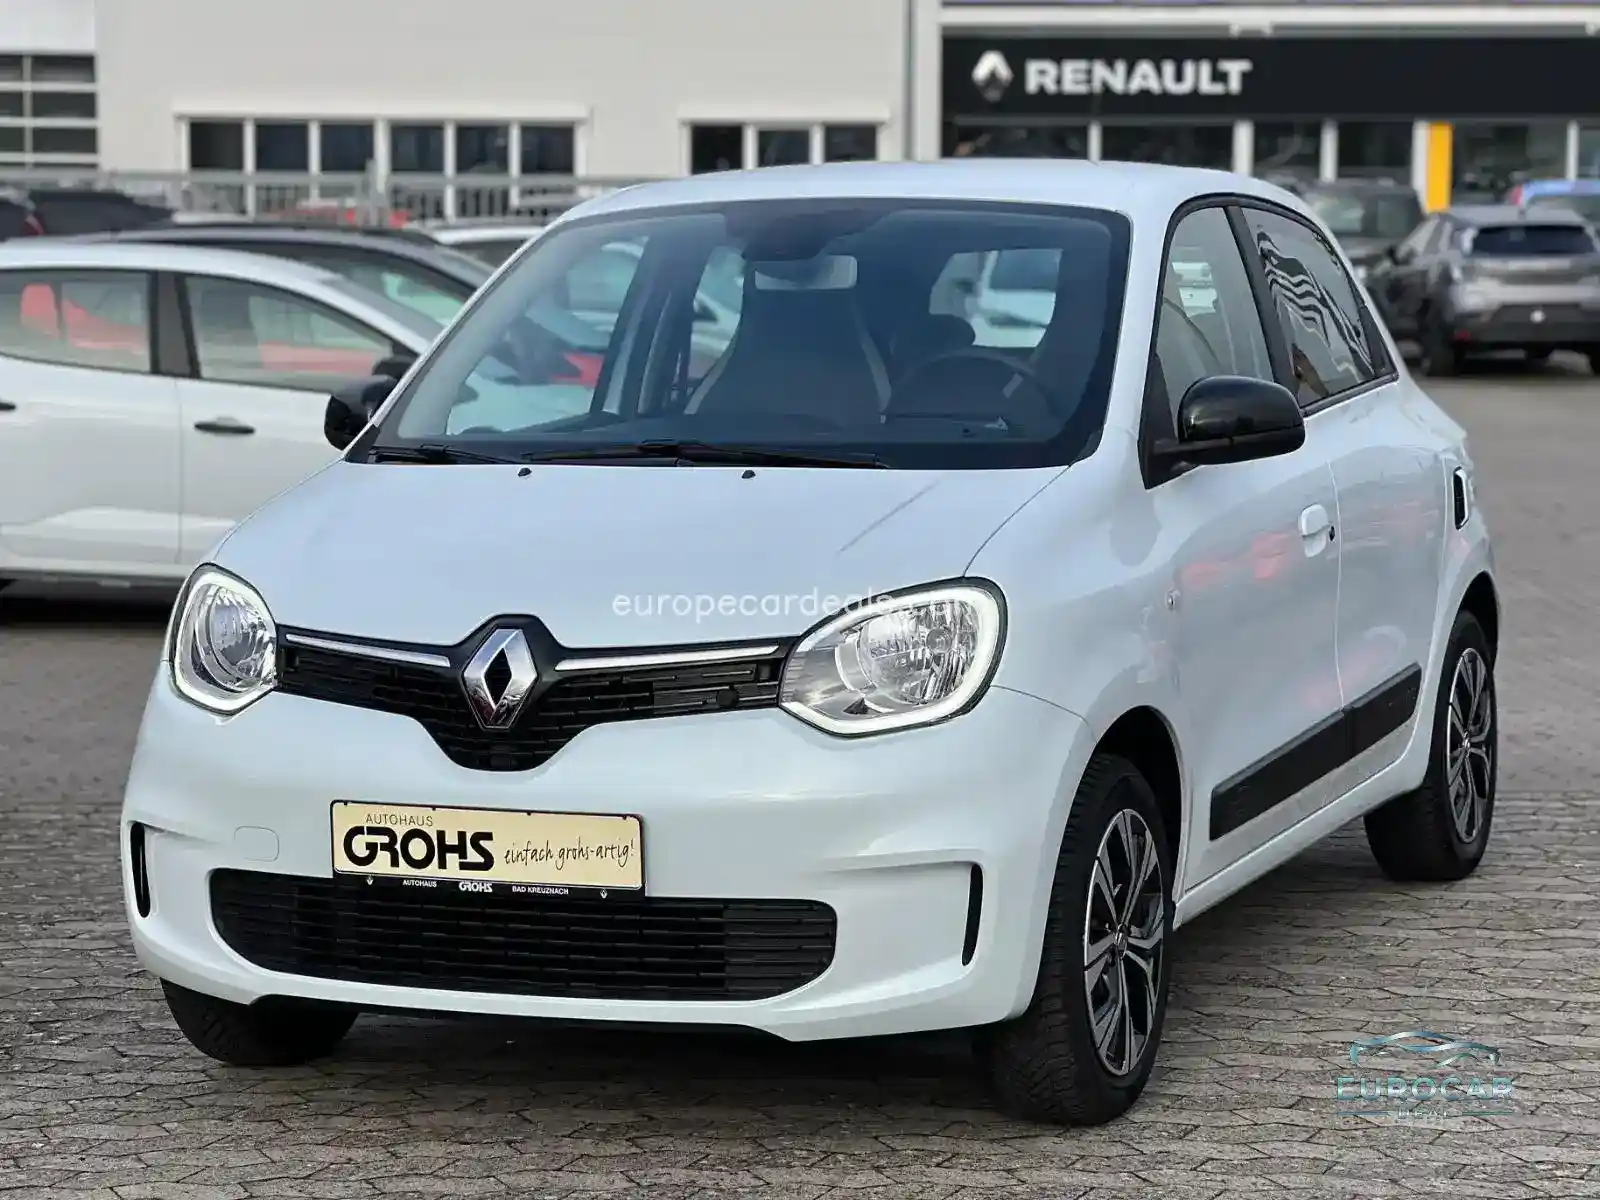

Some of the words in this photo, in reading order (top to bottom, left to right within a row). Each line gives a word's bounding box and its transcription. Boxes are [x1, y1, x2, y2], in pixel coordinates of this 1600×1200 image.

[1024, 58, 1253, 96] RENAULT
[365, 813, 434, 828] AUTOHAUS
[343, 826, 495, 872] GROHS
[504, 838, 554, 866] einfach
[556, 837, 636, 871] grohs-artig!
[402, 879, 437, 889] AUTOHAUS
[458, 880, 493, 893] GROHS
[511, 885, 526, 893] BAD
[527, 886, 569, 896] KREUZNACH
